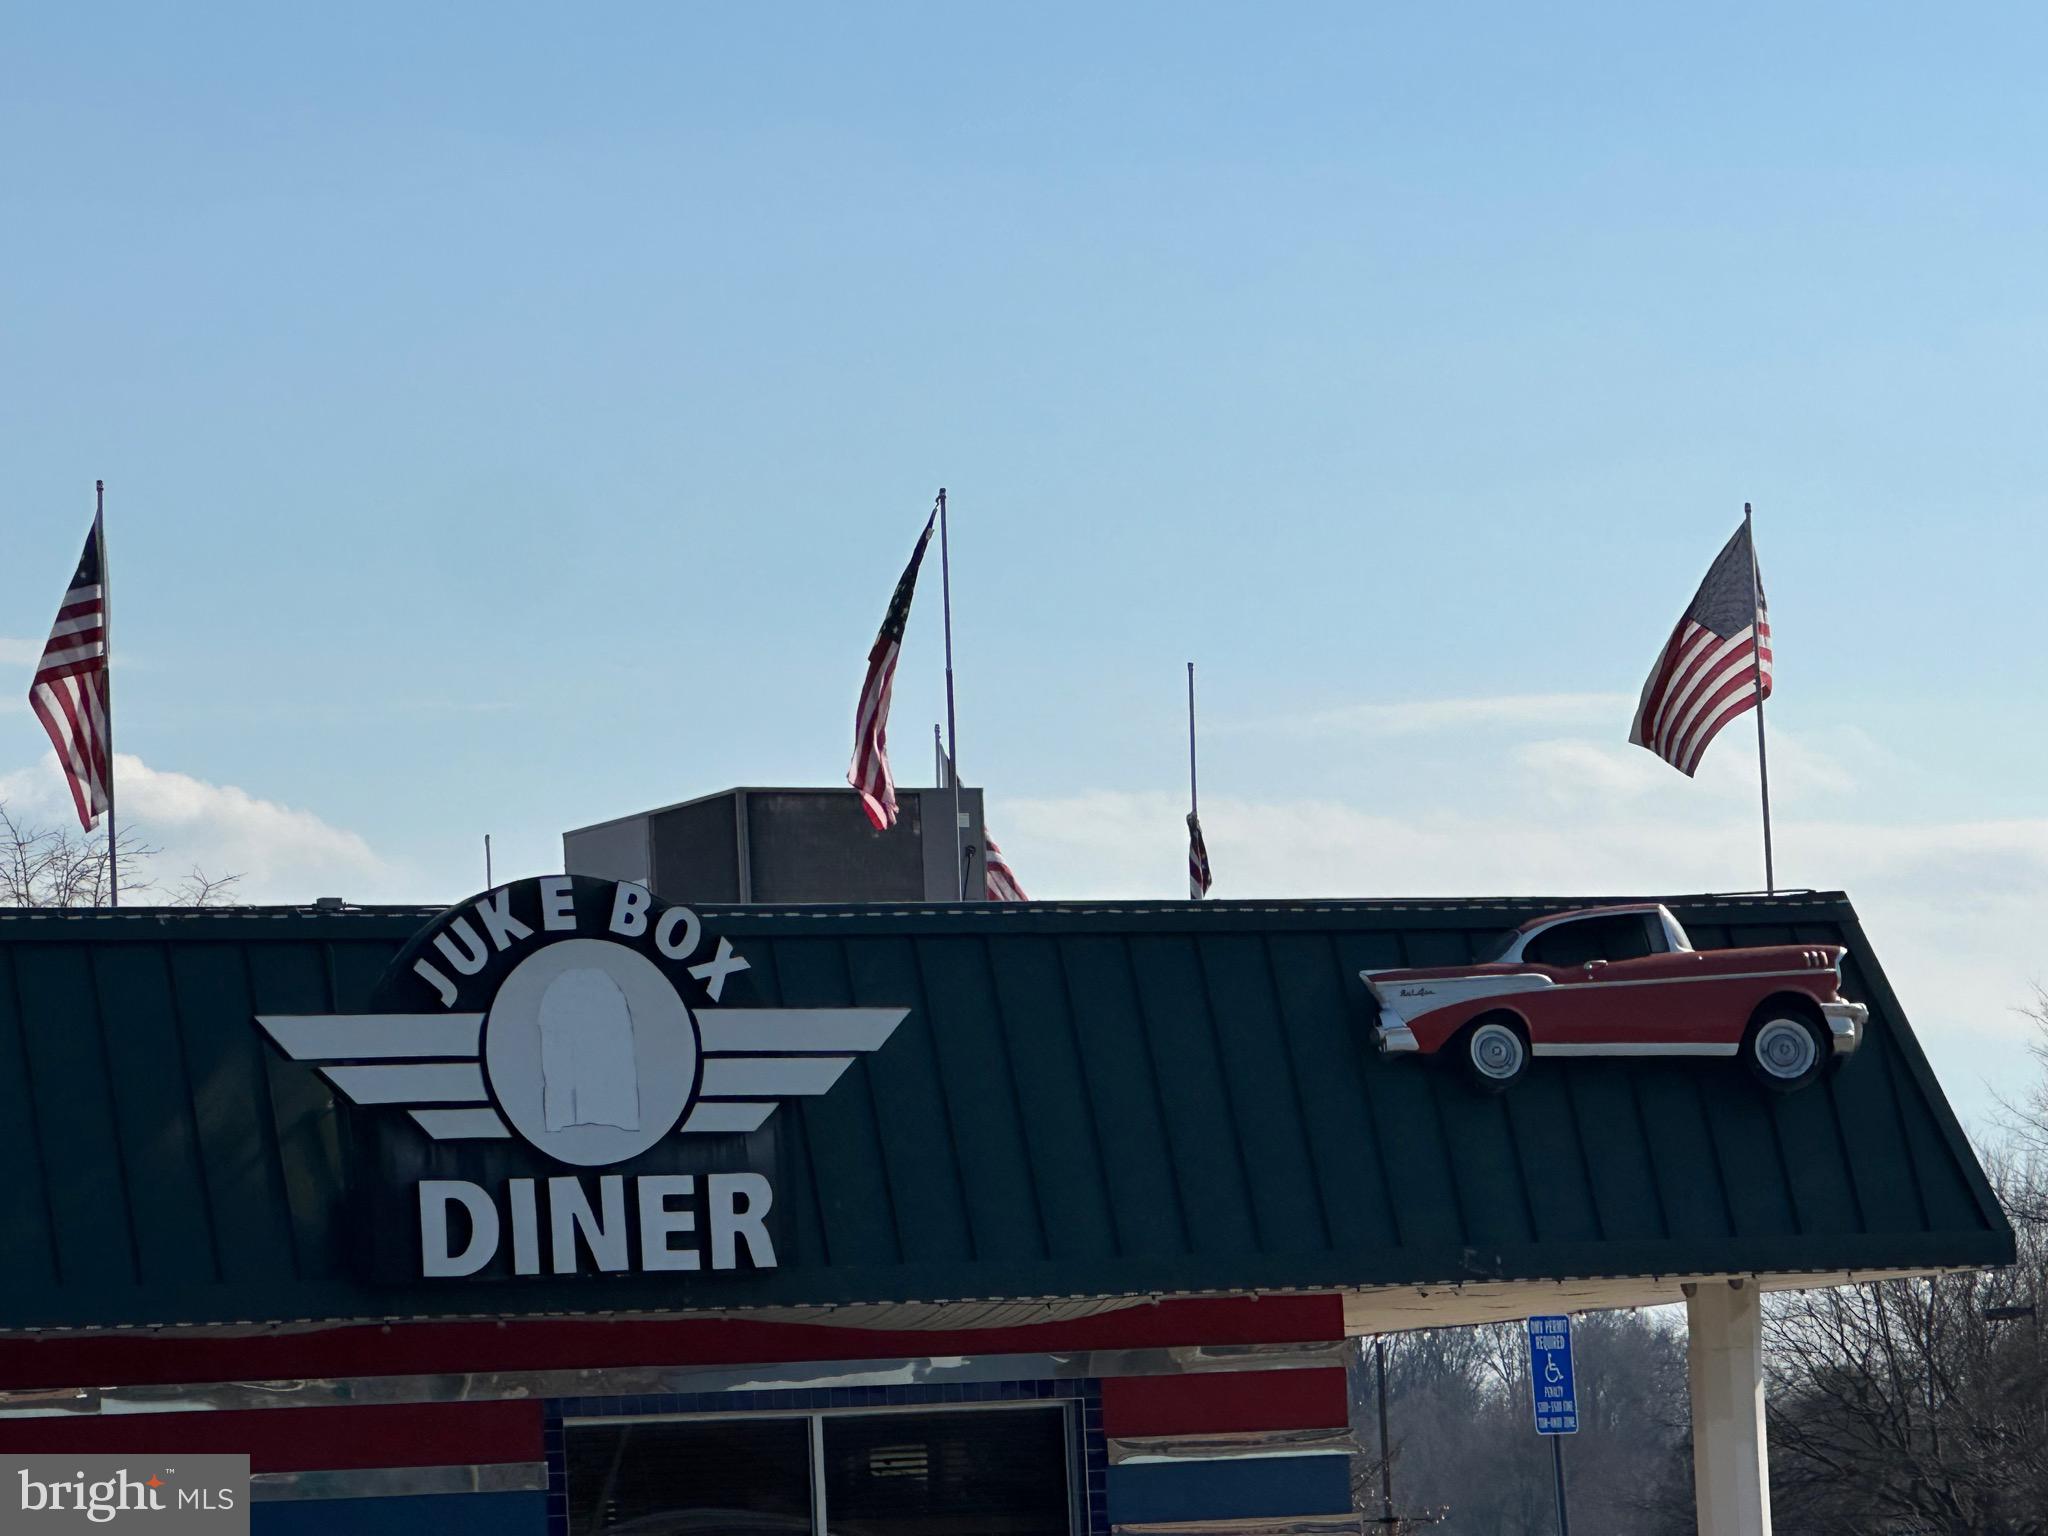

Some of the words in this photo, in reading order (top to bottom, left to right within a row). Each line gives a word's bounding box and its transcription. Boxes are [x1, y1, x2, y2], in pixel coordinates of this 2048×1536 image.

[413, 877, 577, 1008] JUKE
[609, 880, 752, 1003] BOX
[418, 1172, 778, 1278] DINER
